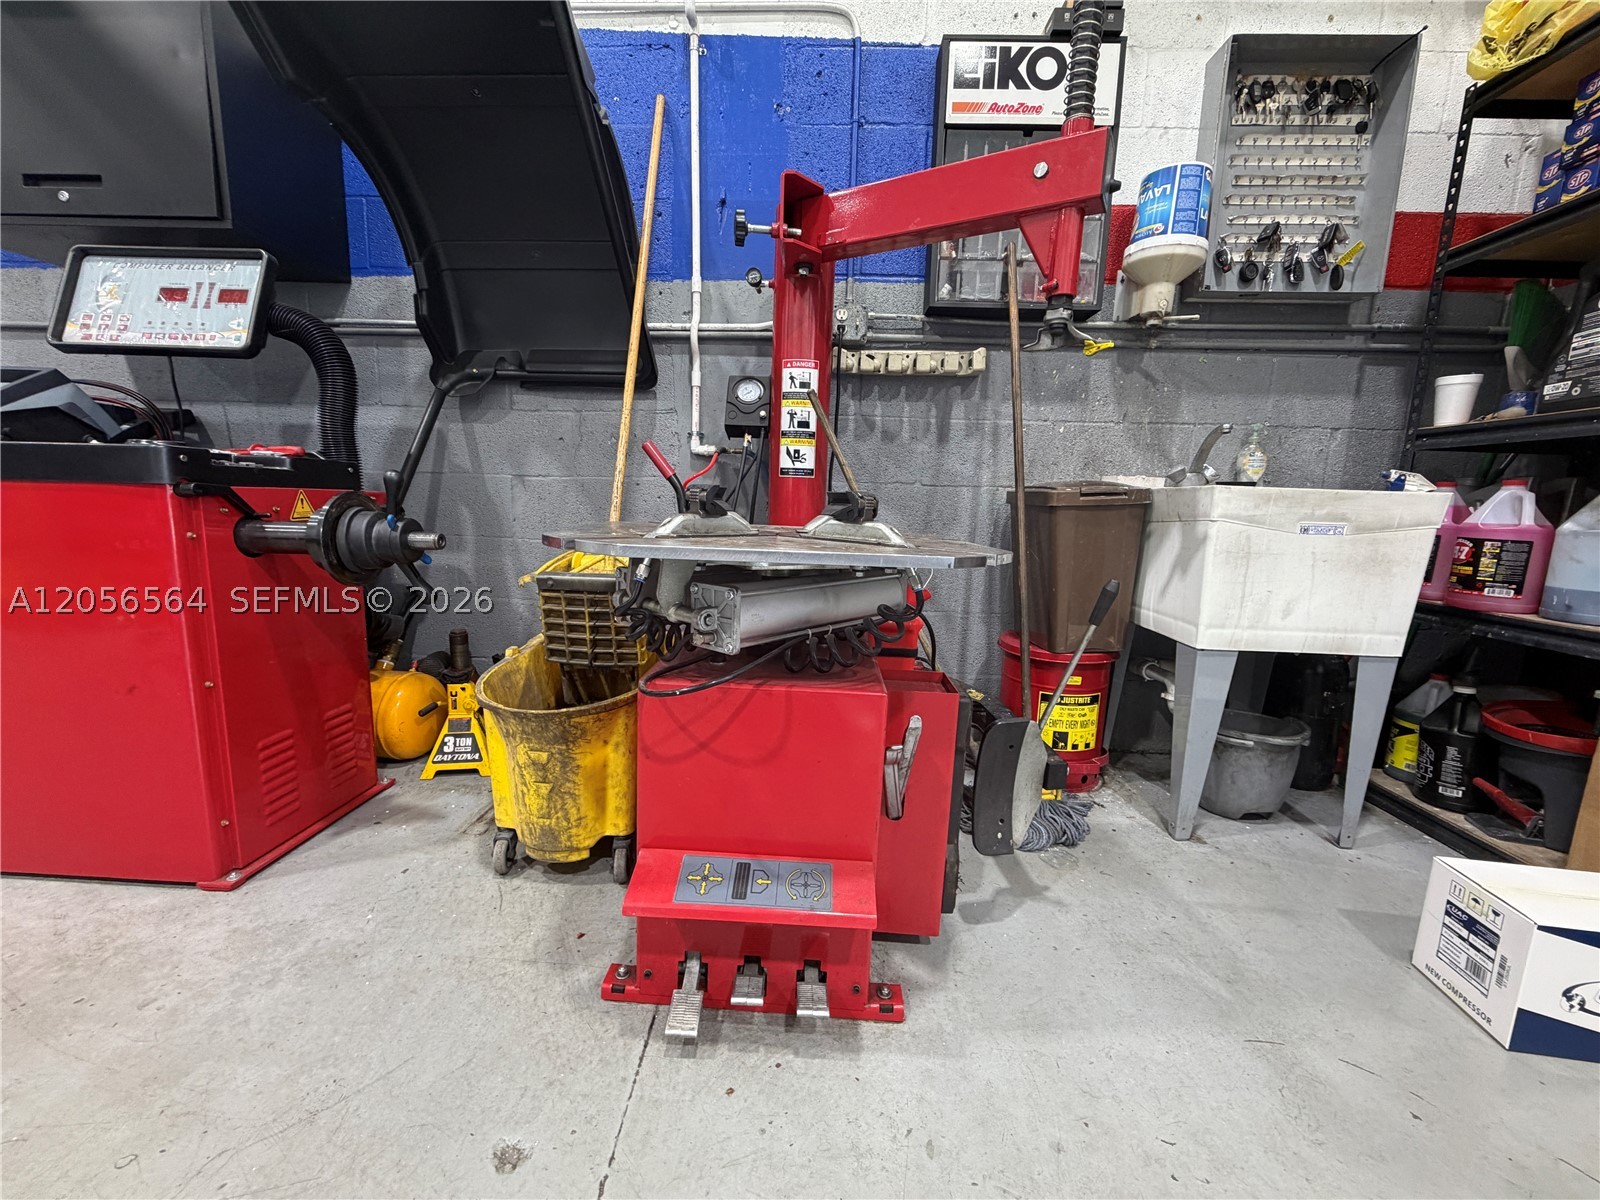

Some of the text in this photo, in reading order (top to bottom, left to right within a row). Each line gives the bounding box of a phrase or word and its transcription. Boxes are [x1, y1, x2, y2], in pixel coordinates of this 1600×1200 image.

[987, 102, 1043, 115] AutoZone
[1575, 124, 1592, 138] STP
[1568, 171, 1589, 188] STP
[112, 262, 237, 272] COMPUTER BALANCER
[1049, 719, 1064, 728] EMPTY
[1065, 720, 1078, 729] EVERY
[443, 736, 472, 752] 3 TON
[433, 753, 480, 762] DAYTONA
[1451, 906, 1469, 921] UAC
[1425, 963, 1441, 981] NEW
[1441, 978, 1492, 1027] COMPRESSOR
